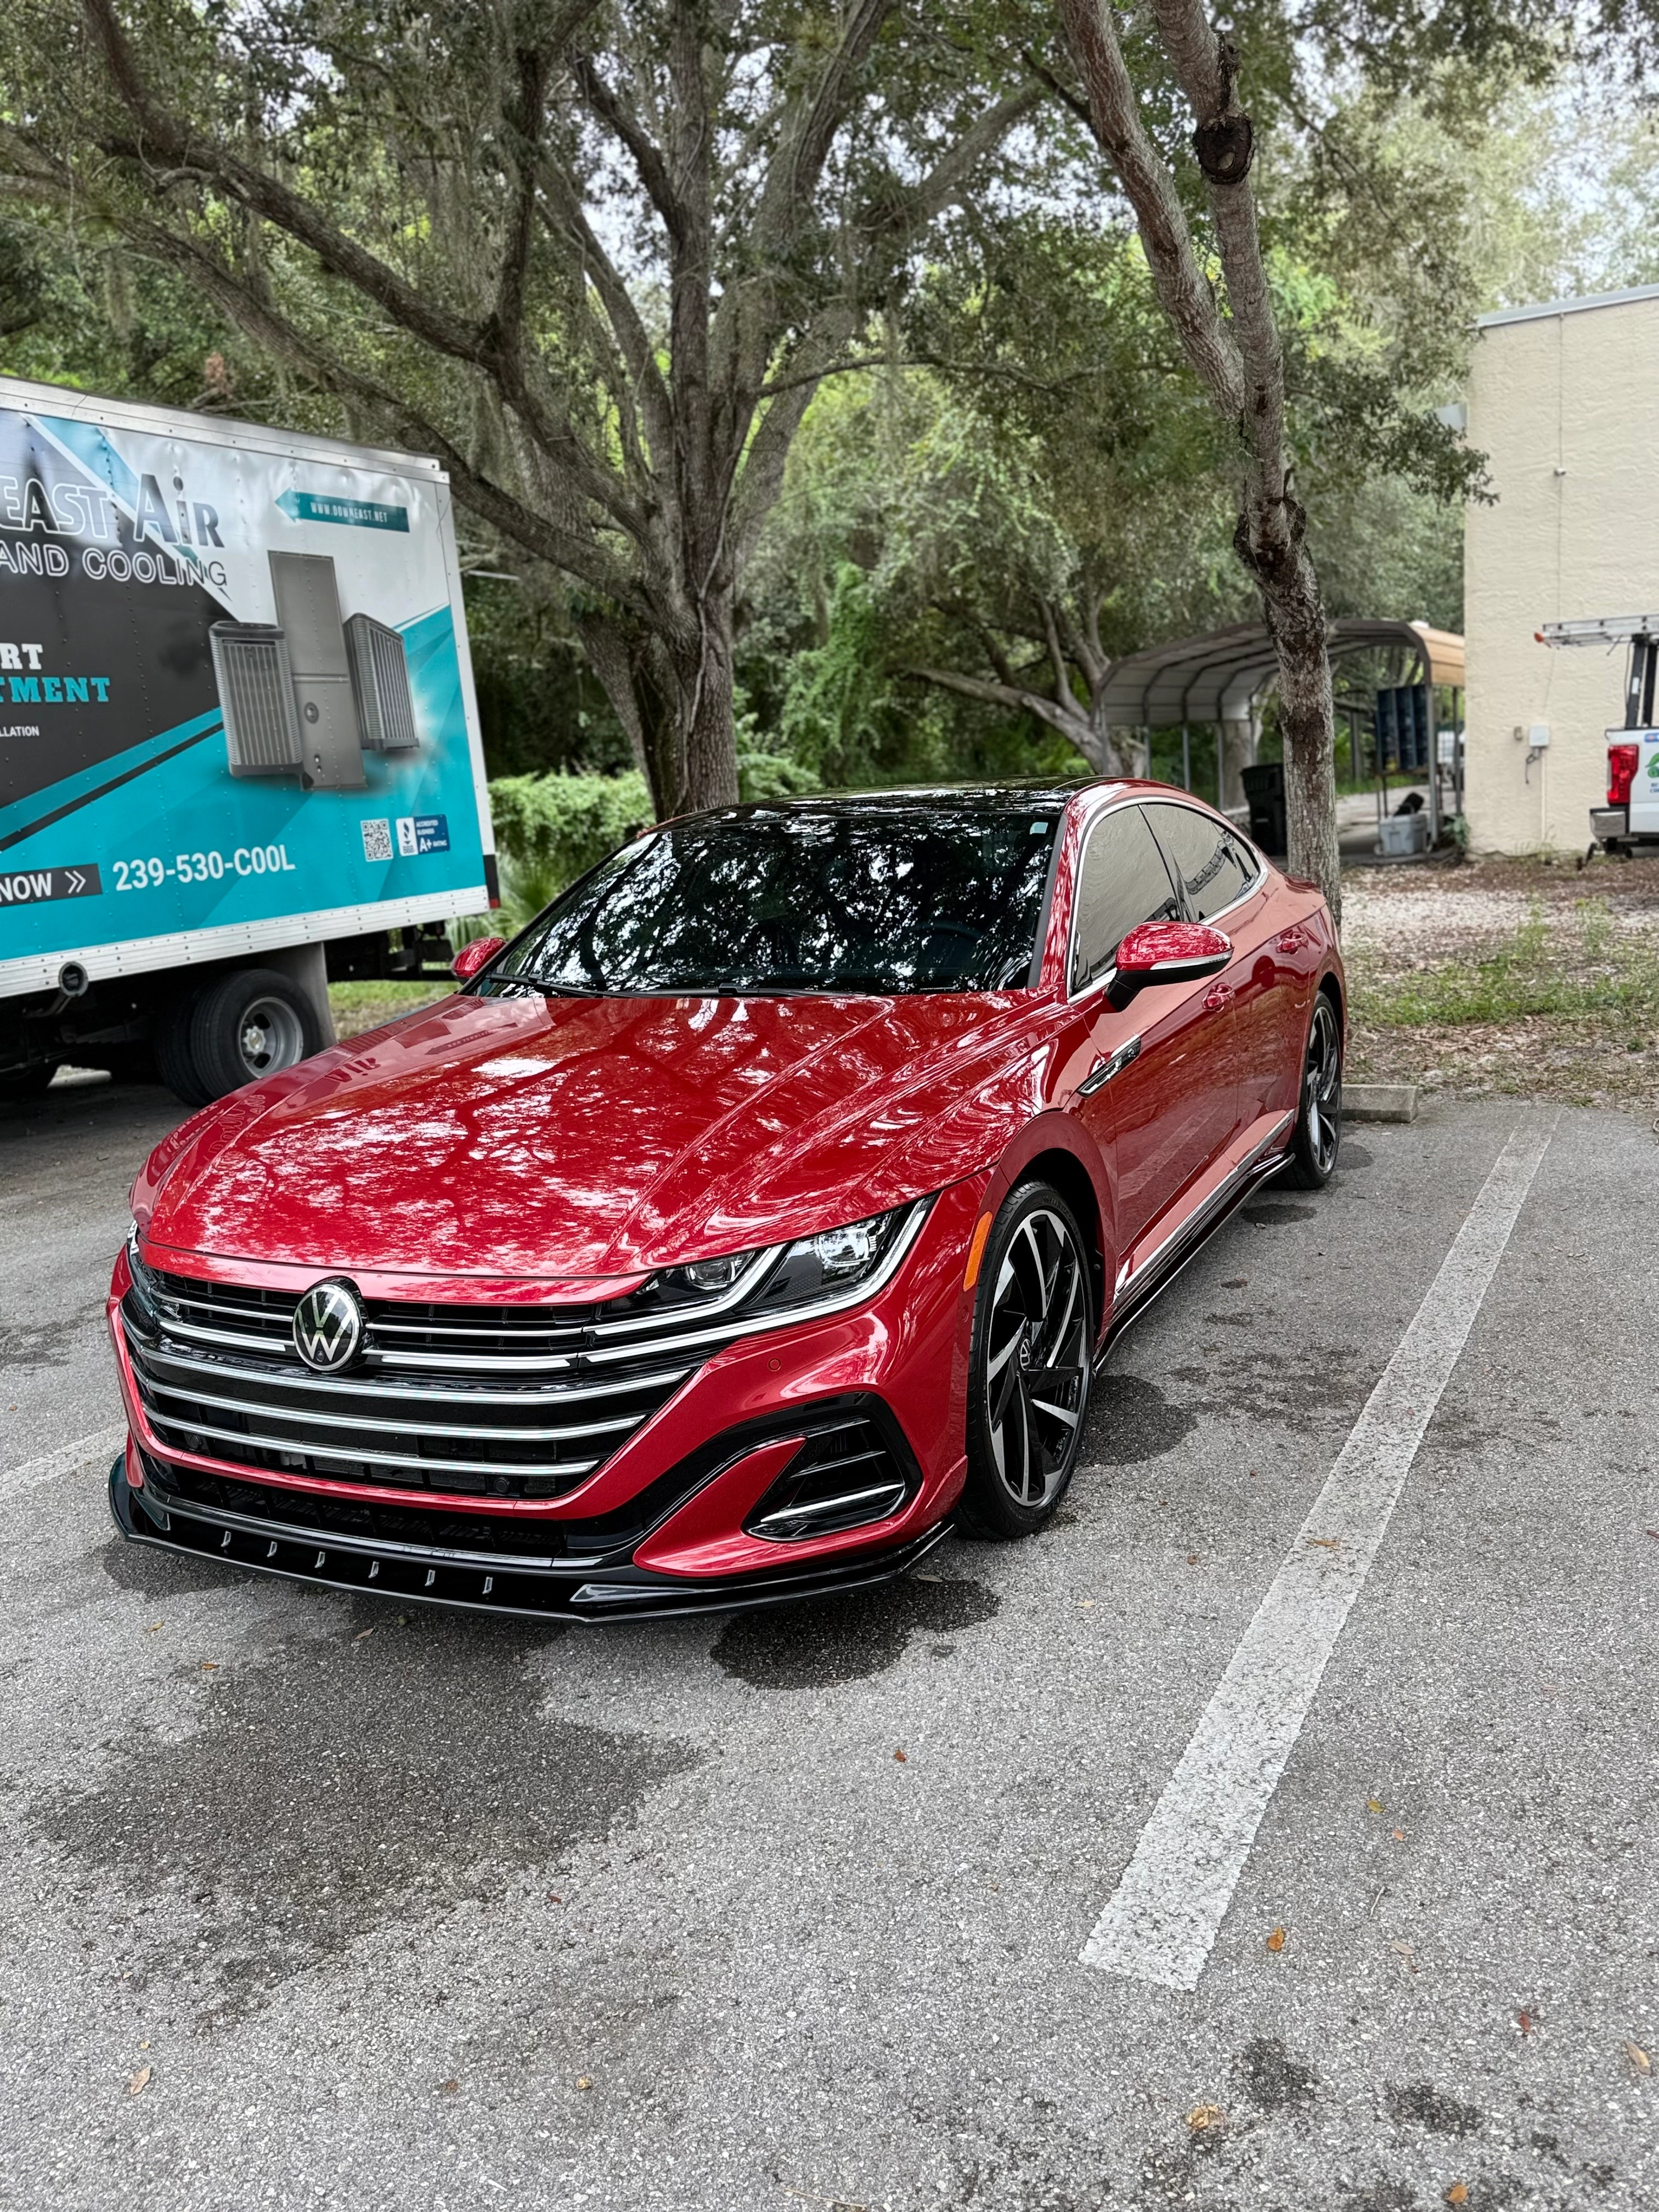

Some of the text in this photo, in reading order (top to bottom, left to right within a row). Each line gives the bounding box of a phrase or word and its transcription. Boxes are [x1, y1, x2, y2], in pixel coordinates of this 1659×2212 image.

[310, 502, 387, 523] WWW.DOWNEAST.NET
[82, 548, 228, 586] COOLING
[0, 872, 52, 902] NOW
